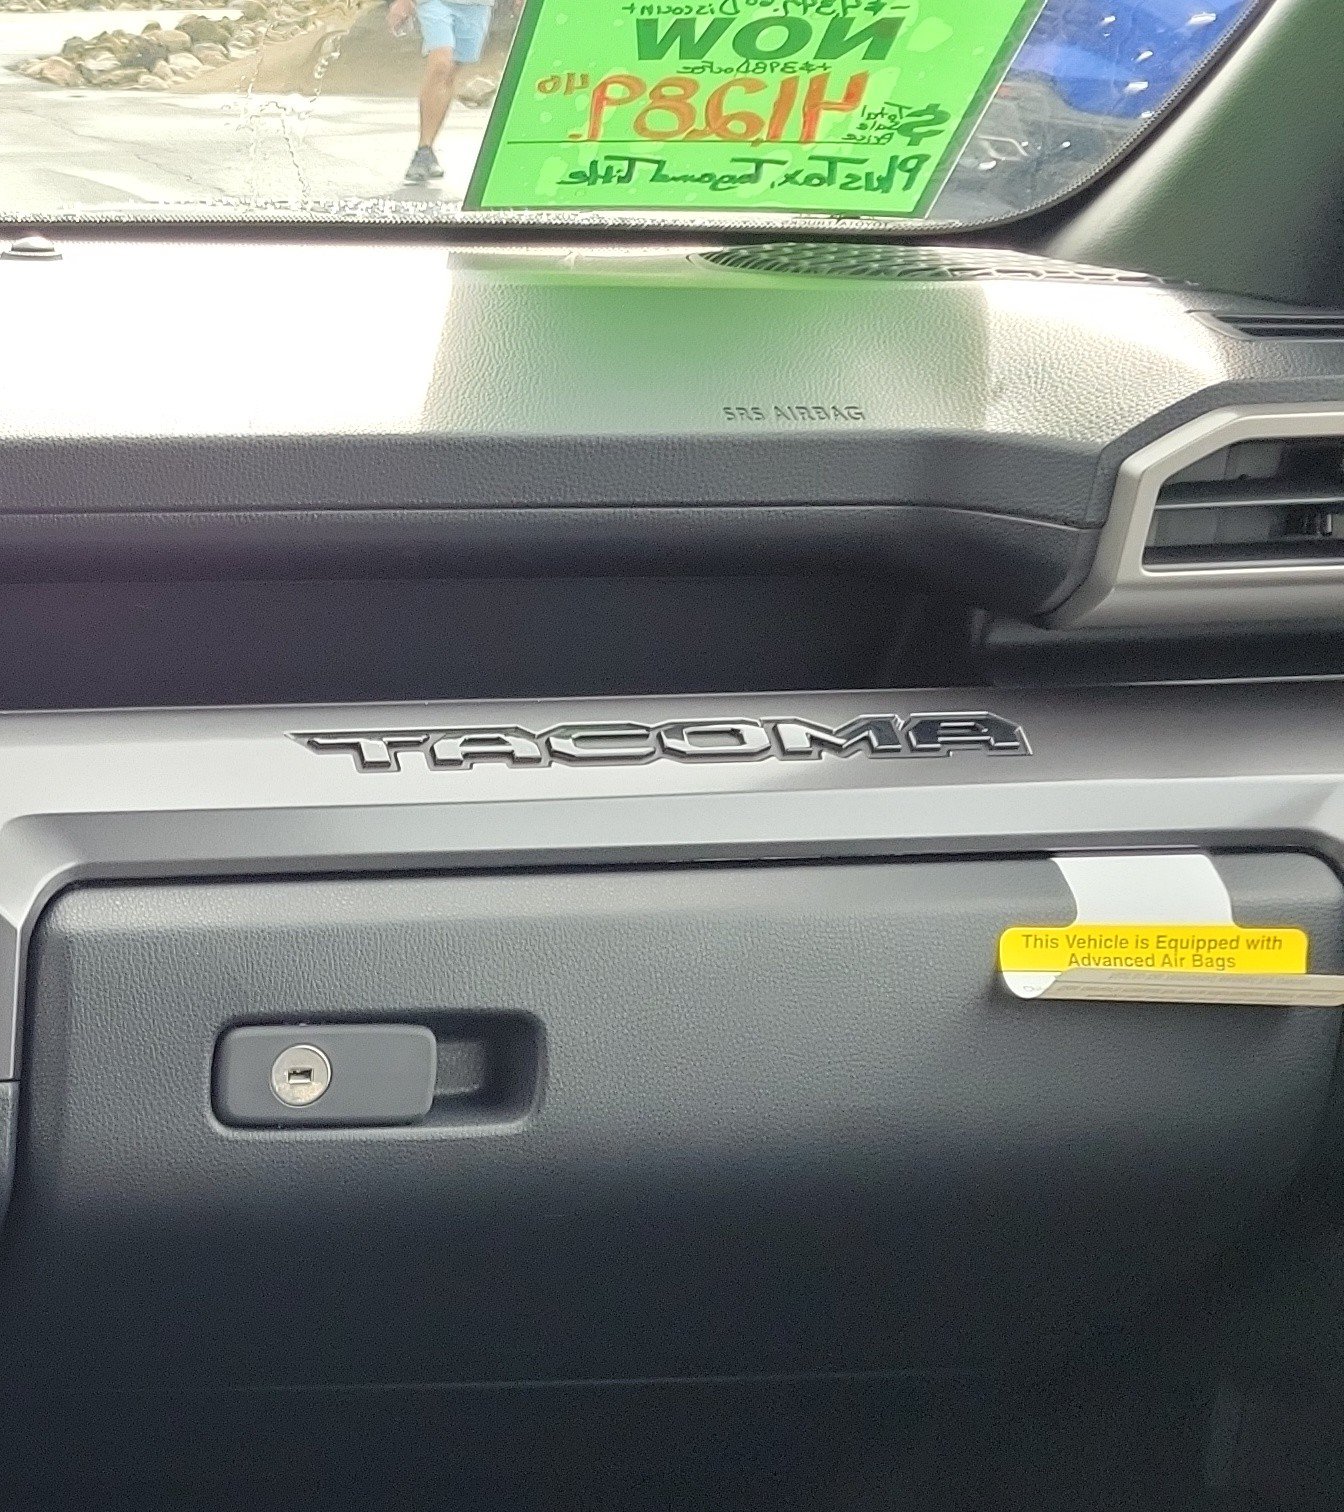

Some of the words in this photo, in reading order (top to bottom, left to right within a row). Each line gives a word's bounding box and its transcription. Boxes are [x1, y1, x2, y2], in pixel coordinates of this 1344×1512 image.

[723, 406, 764, 421] SRS
[773, 405, 865, 421] AIRBAG
[285, 711, 1032, 773] TACOMA
[1022, 934, 1059, 950] This
[1065, 934, 1129, 950] Vehicle
[1135, 934, 1150, 950] is
[1156, 934, 1240, 954] Equipped
[1245, 935, 1283, 950] with
[1068, 952, 1155, 968] Advanced
[1162, 953, 1186, 968] Air
[1192, 954, 1237, 971] Bags
